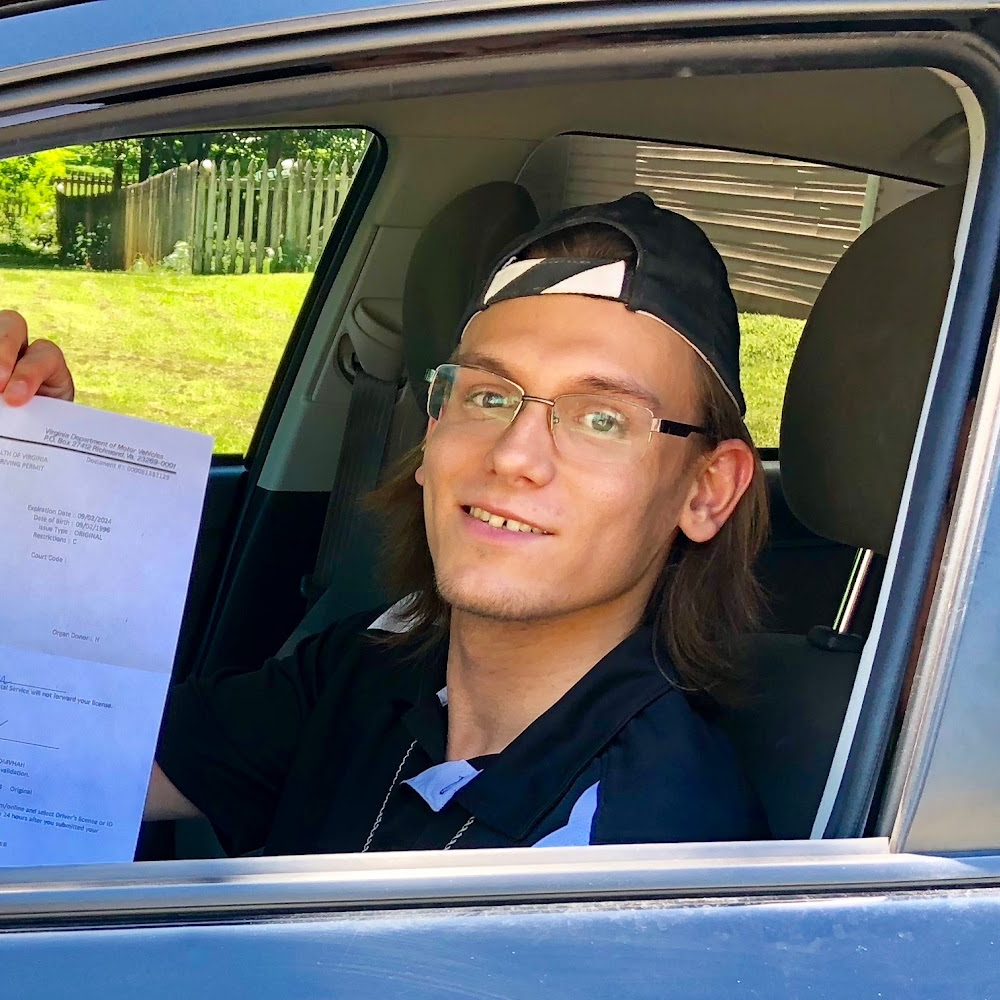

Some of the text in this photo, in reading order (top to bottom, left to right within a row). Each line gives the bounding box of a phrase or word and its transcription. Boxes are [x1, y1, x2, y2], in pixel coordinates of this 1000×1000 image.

[45, 428, 69, 439] Virginia
[70, 433, 108, 447] Department
[116, 444, 137, 453] Motor
[138, 448, 163, 460] Vehicles
[57, 437, 71, 446] Box
[22, 453, 48, 463] VIRGINIA
[21, 461, 44, 471] PERMIT
[27, 504, 56, 516] Expiration
[57, 509, 71, 518] Date
[33, 514, 47, 523] Date
[55, 517, 70, 526] Birth
[33, 531, 66, 543] Restrictions
[38, 523, 102, 540] Issue Type ORIGINAL
[30, 551, 63, 563] Court Code
[52, 629, 89, 640] Organ Donor
[9, 685, 30, 694] Service
[30, 688, 41, 696] will
[53, 692, 76, 702] forward
[9, 785, 32, 795] Original
[11, 813, 27, 821] hours
[55, 821, 84, 831] submitted
[37, 809, 54, 817] select
[55, 812, 77, 821] Driver's
[77, 816, 98, 825] license
